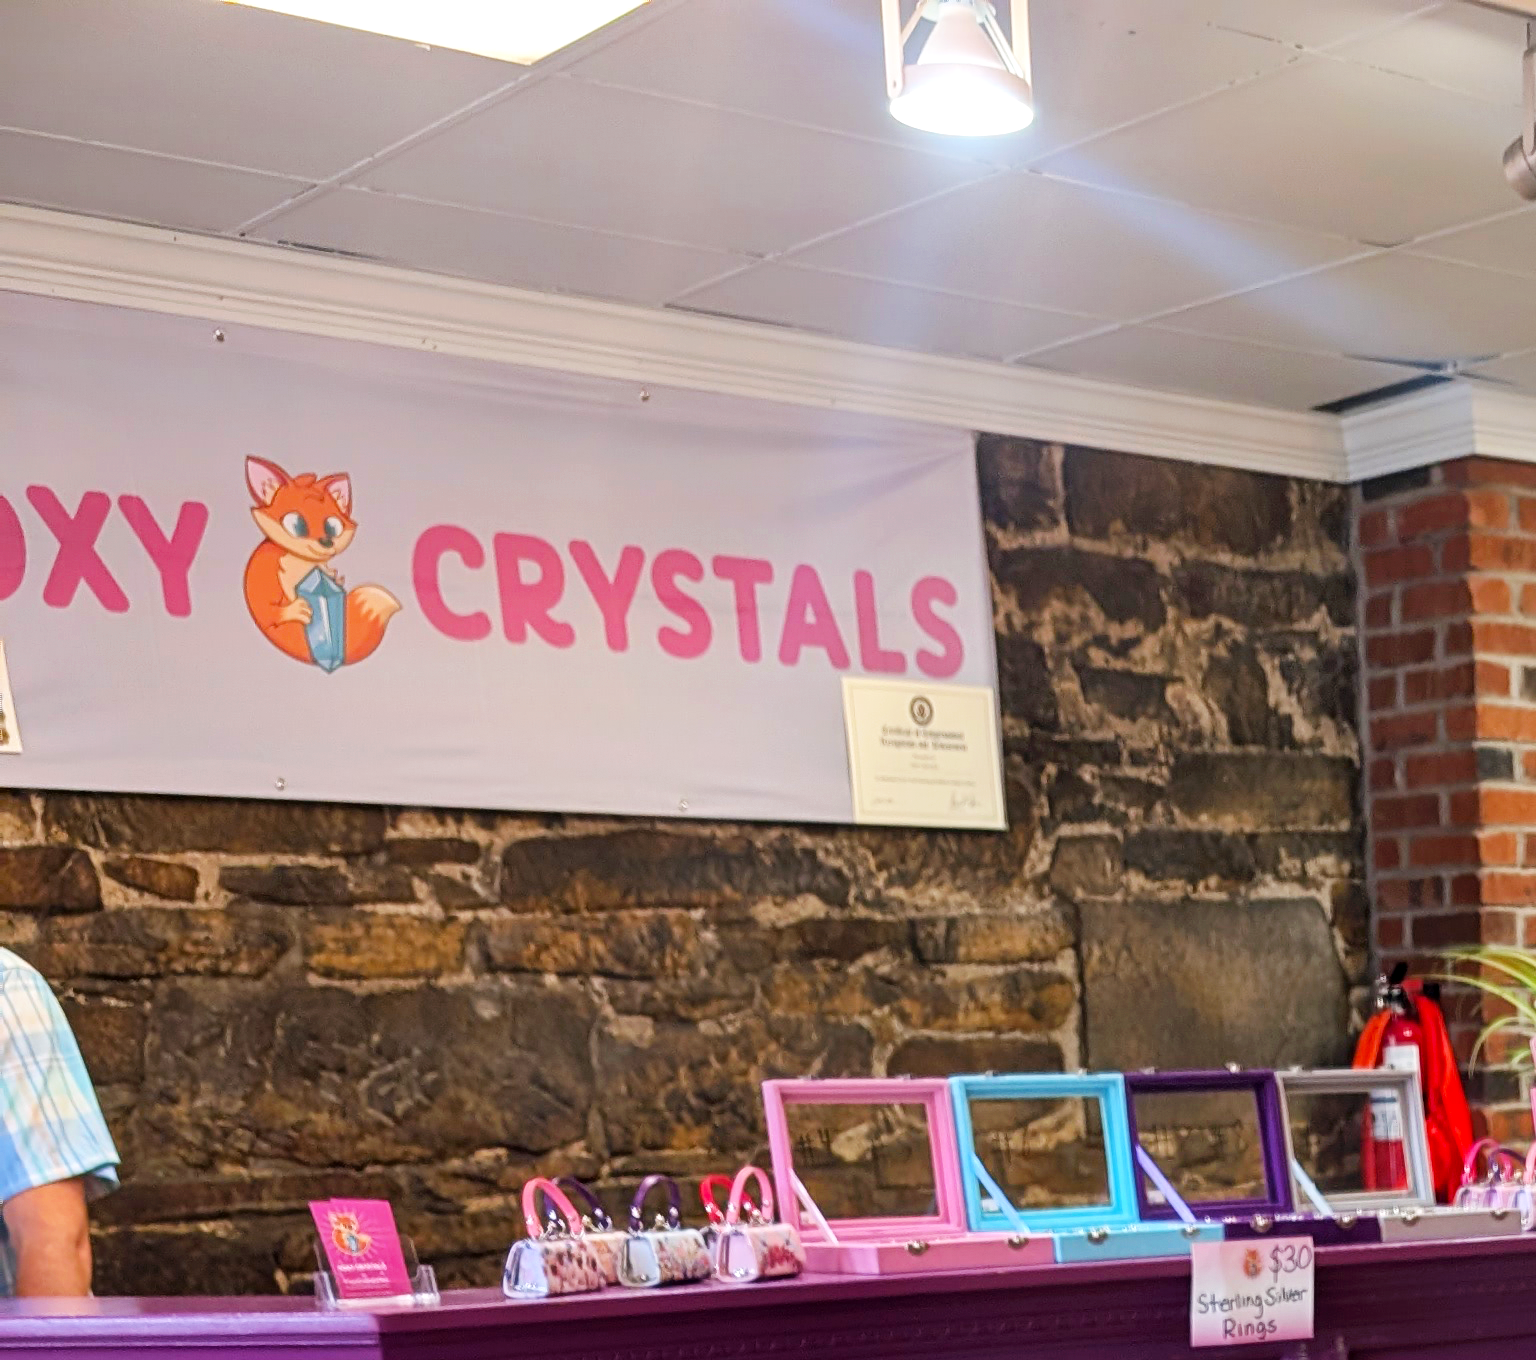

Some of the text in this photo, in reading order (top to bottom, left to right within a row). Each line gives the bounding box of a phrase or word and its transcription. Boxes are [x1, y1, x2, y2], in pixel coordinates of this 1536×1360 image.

[411, 523, 963, 679] CRYSTALS
[1269, 1244, 1313, 1283] $30
[1197, 1286, 1308, 1319] Sterling Silver
[1222, 1317, 1277, 1340] Rings
